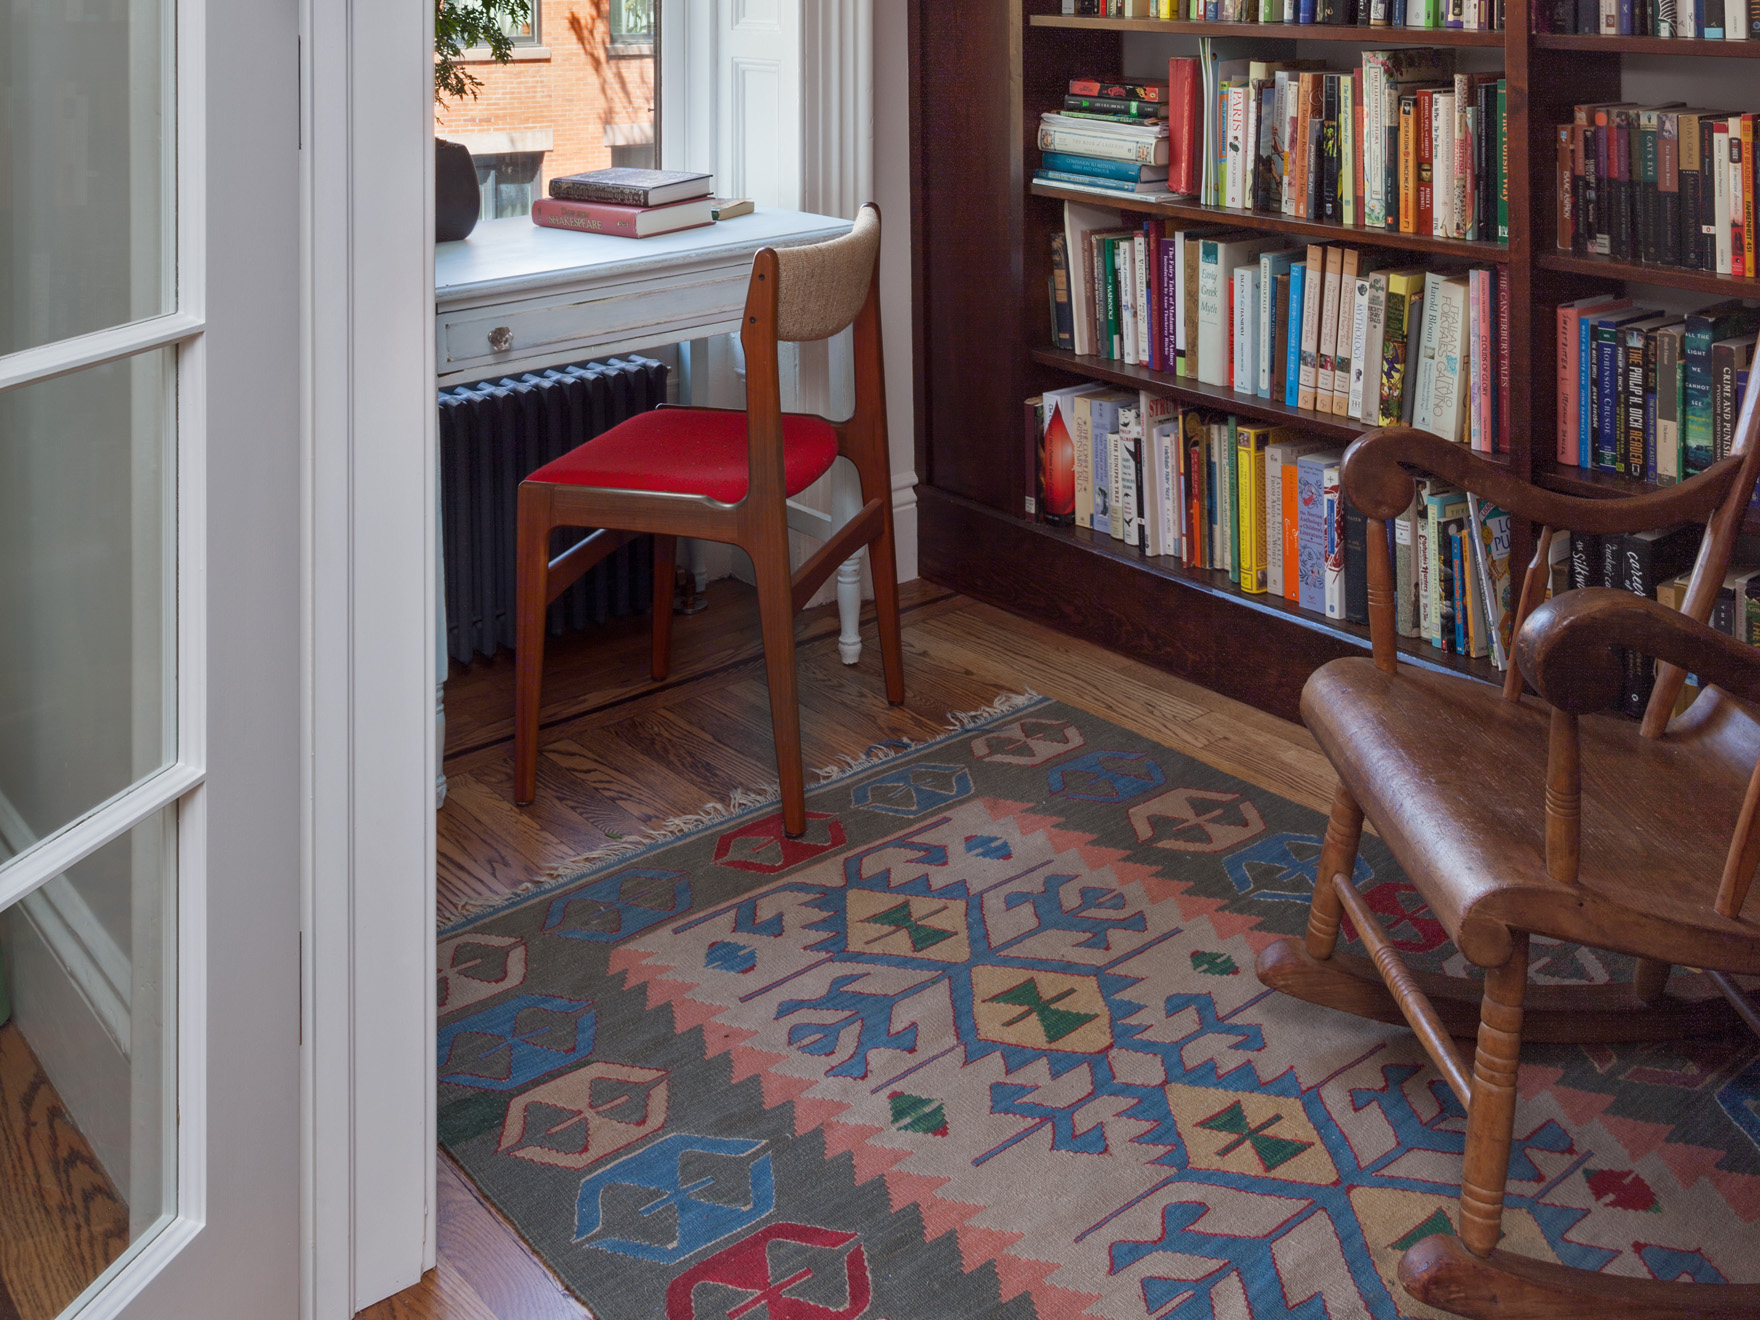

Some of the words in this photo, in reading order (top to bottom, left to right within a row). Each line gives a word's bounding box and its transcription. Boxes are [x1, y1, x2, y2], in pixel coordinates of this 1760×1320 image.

[549, 215, 603, 230] SHAKESPEARE
[1429, 282, 1439, 312] Harold
[1353, 303, 1363, 361] MYTHOLOGY
[1426, 314, 1436, 342] Bloom
[1603, 347, 1611, 394] ROBINSON
[1629, 349, 1643, 365] THE
[1629, 367, 1643, 395] PHILIP
[1723, 367, 1731, 397] CRIME
[1604, 398, 1612, 434] CRUSOE
[1629, 407, 1643, 428] DICK
[1723, 400, 1731, 420] AND
[1630, 430, 1643, 464] READER
[1723, 423, 1731, 461] PUNISH
